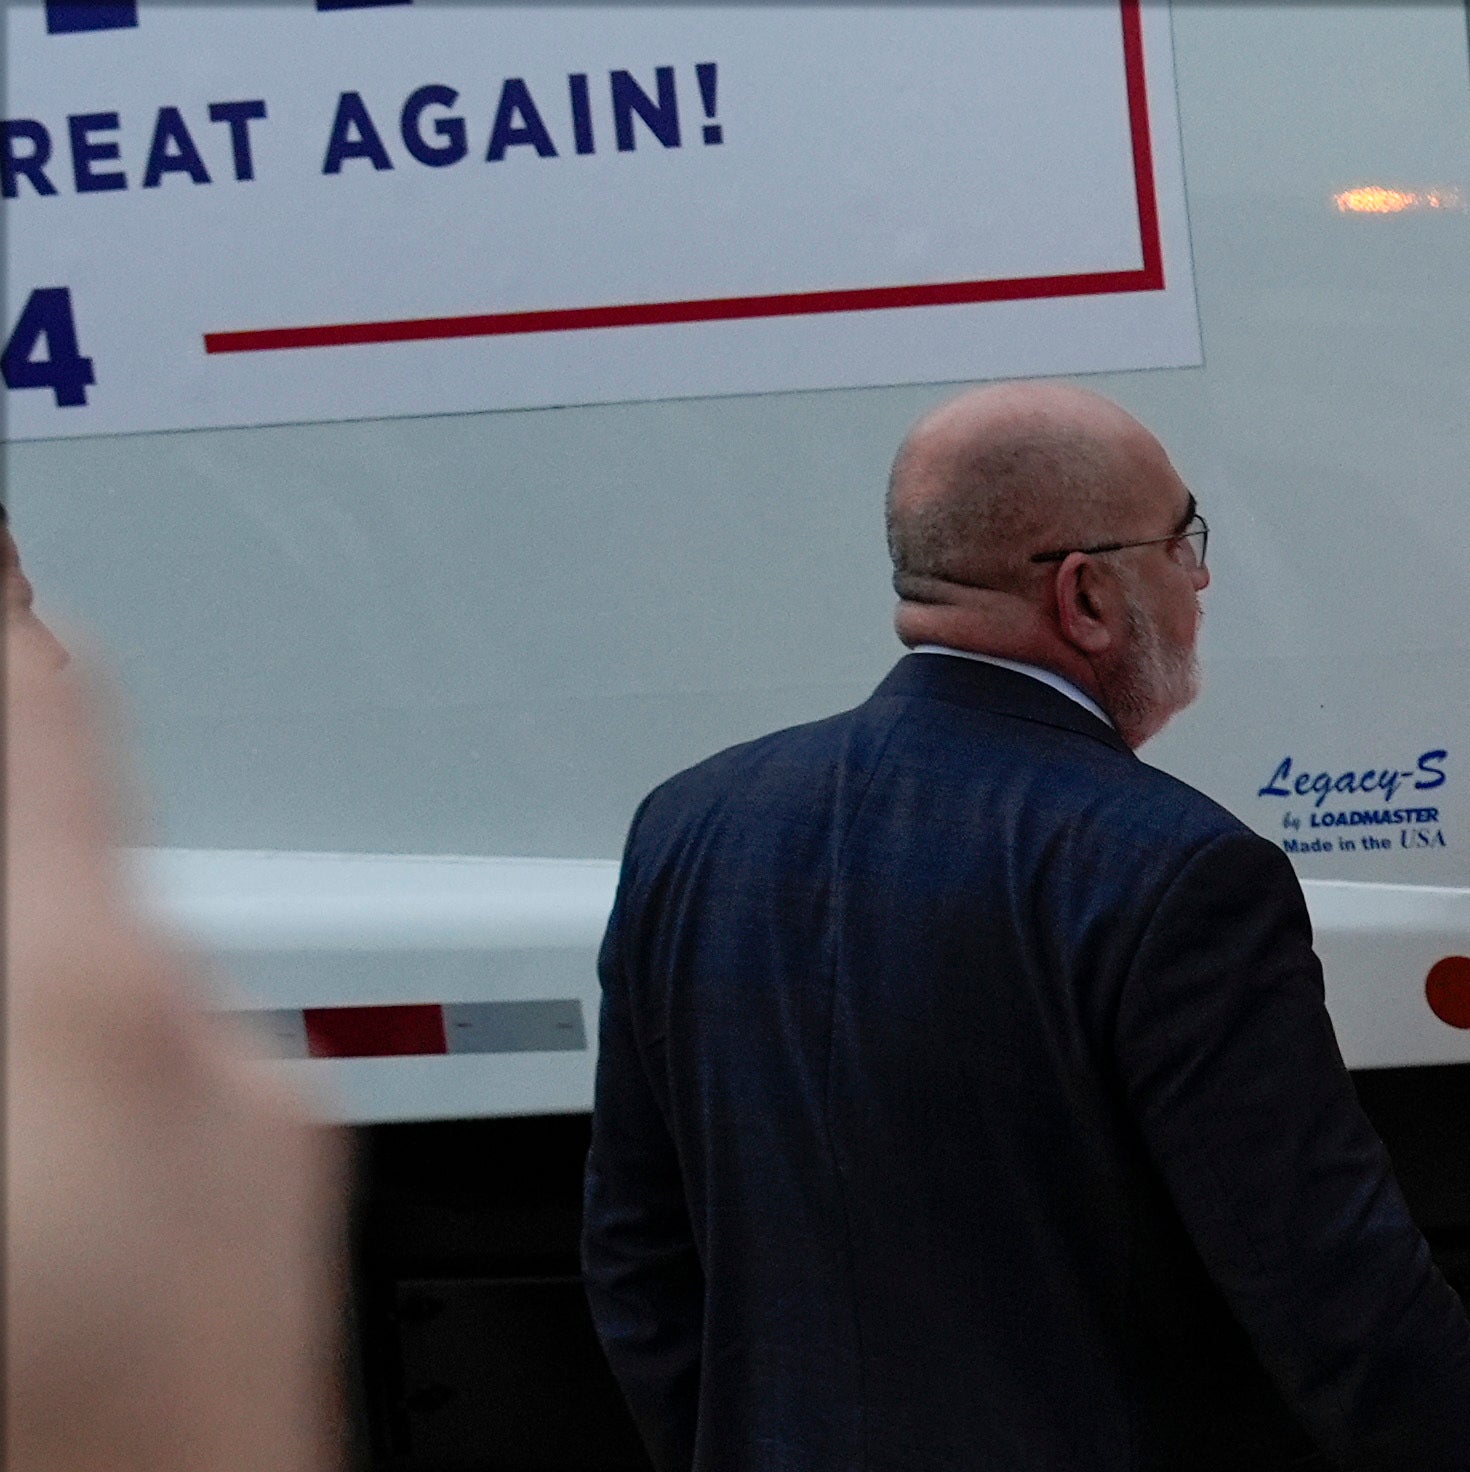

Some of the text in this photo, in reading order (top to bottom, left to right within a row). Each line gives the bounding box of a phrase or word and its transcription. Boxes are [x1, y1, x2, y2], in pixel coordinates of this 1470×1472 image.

[322, 62, 724, 176] AGAIN!
[1258, 750, 1448, 807] Legacy-S
[1310, 807, 1439, 827] LOADMASTER
[1283, 829, 1447, 853] Made in the USA
